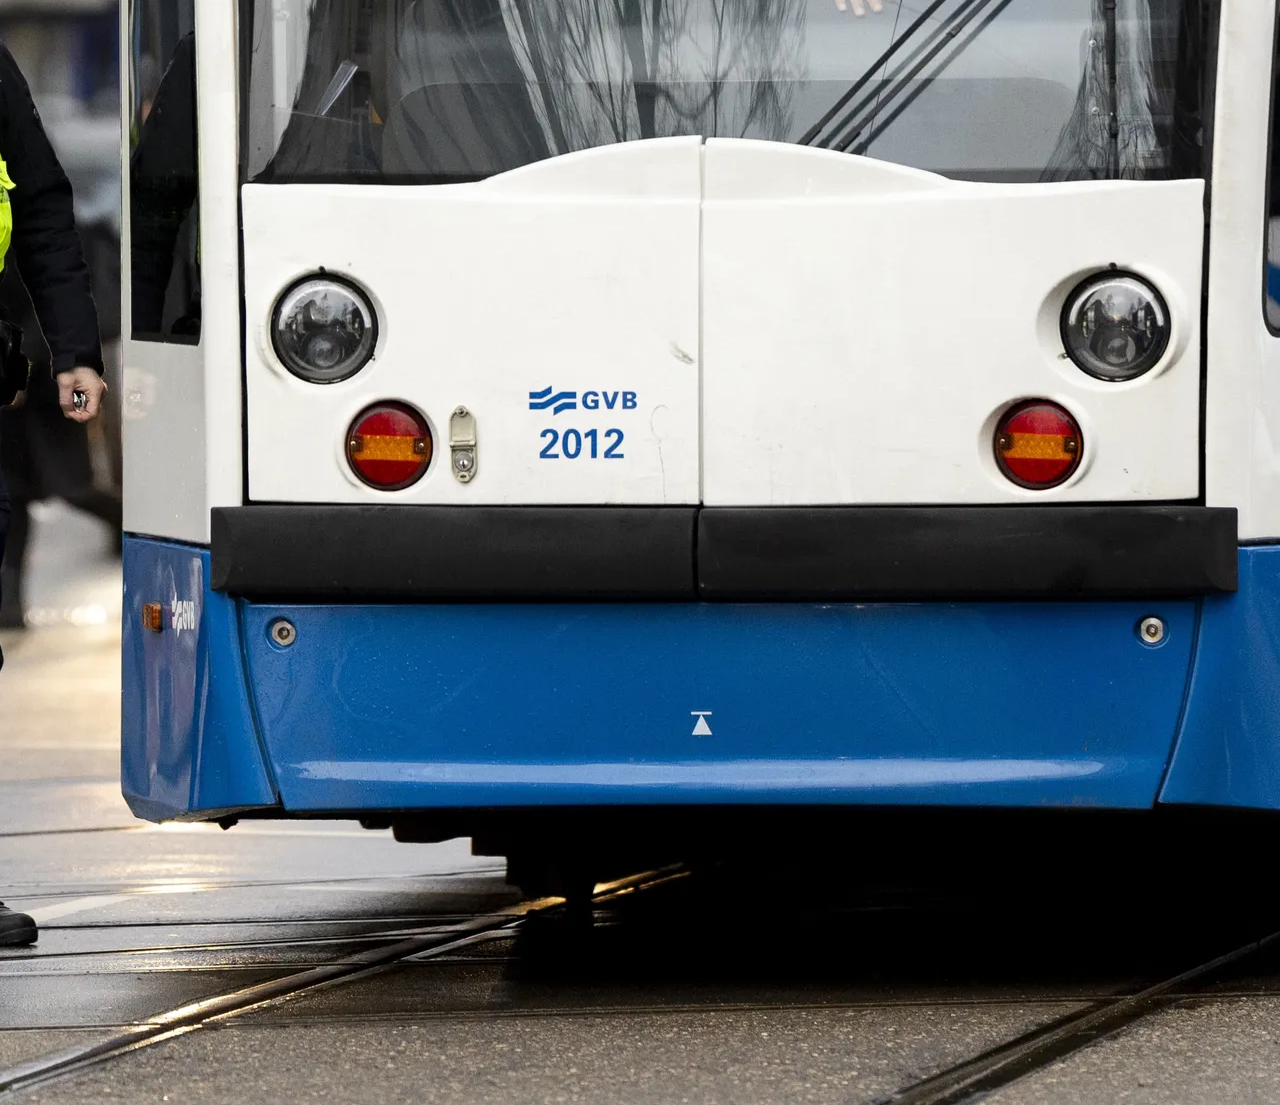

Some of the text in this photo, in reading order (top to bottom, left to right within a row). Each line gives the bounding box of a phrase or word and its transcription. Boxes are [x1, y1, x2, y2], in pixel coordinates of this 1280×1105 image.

[581, 391, 638, 410] GVB
[539, 428, 625, 460] 2012
[182, 600, 195, 630] GVB
